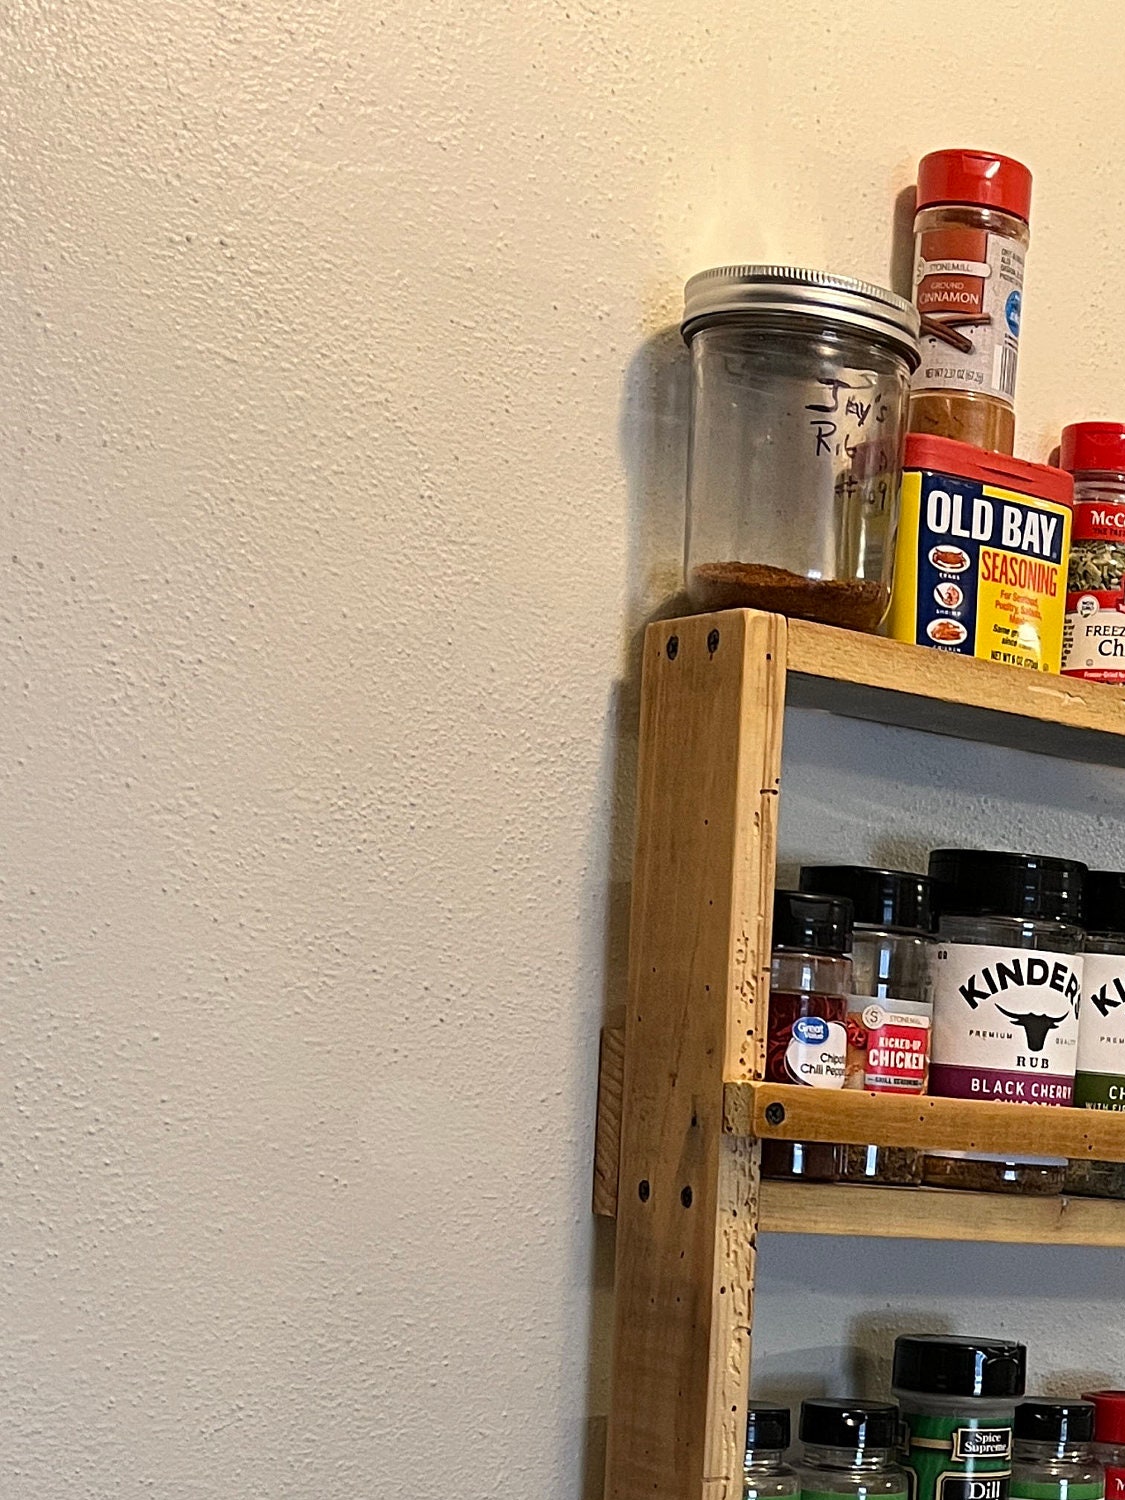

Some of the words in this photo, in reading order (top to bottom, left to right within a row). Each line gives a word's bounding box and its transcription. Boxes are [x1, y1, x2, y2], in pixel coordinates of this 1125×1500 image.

[926, 490, 993, 541] OLD
[1002, 505, 1057, 557] BAY
[981, 550, 1058, 597] SEASONING
[798, 1022, 824, 1035] Great
[969, 1029, 1013, 1039] PREMIUM
[878, 1036, 922, 1049] KICKED-UP
[801, 1063, 823, 1075] Chili
[1016, 1056, 1049, 1069] RUB
[971, 1078, 1025, 1096] BLACK
[975, 1432, 1001, 1444] Spice
[964, 1442, 1007, 1454] Supreme
[970, 1481, 1000, 1500] Dill
